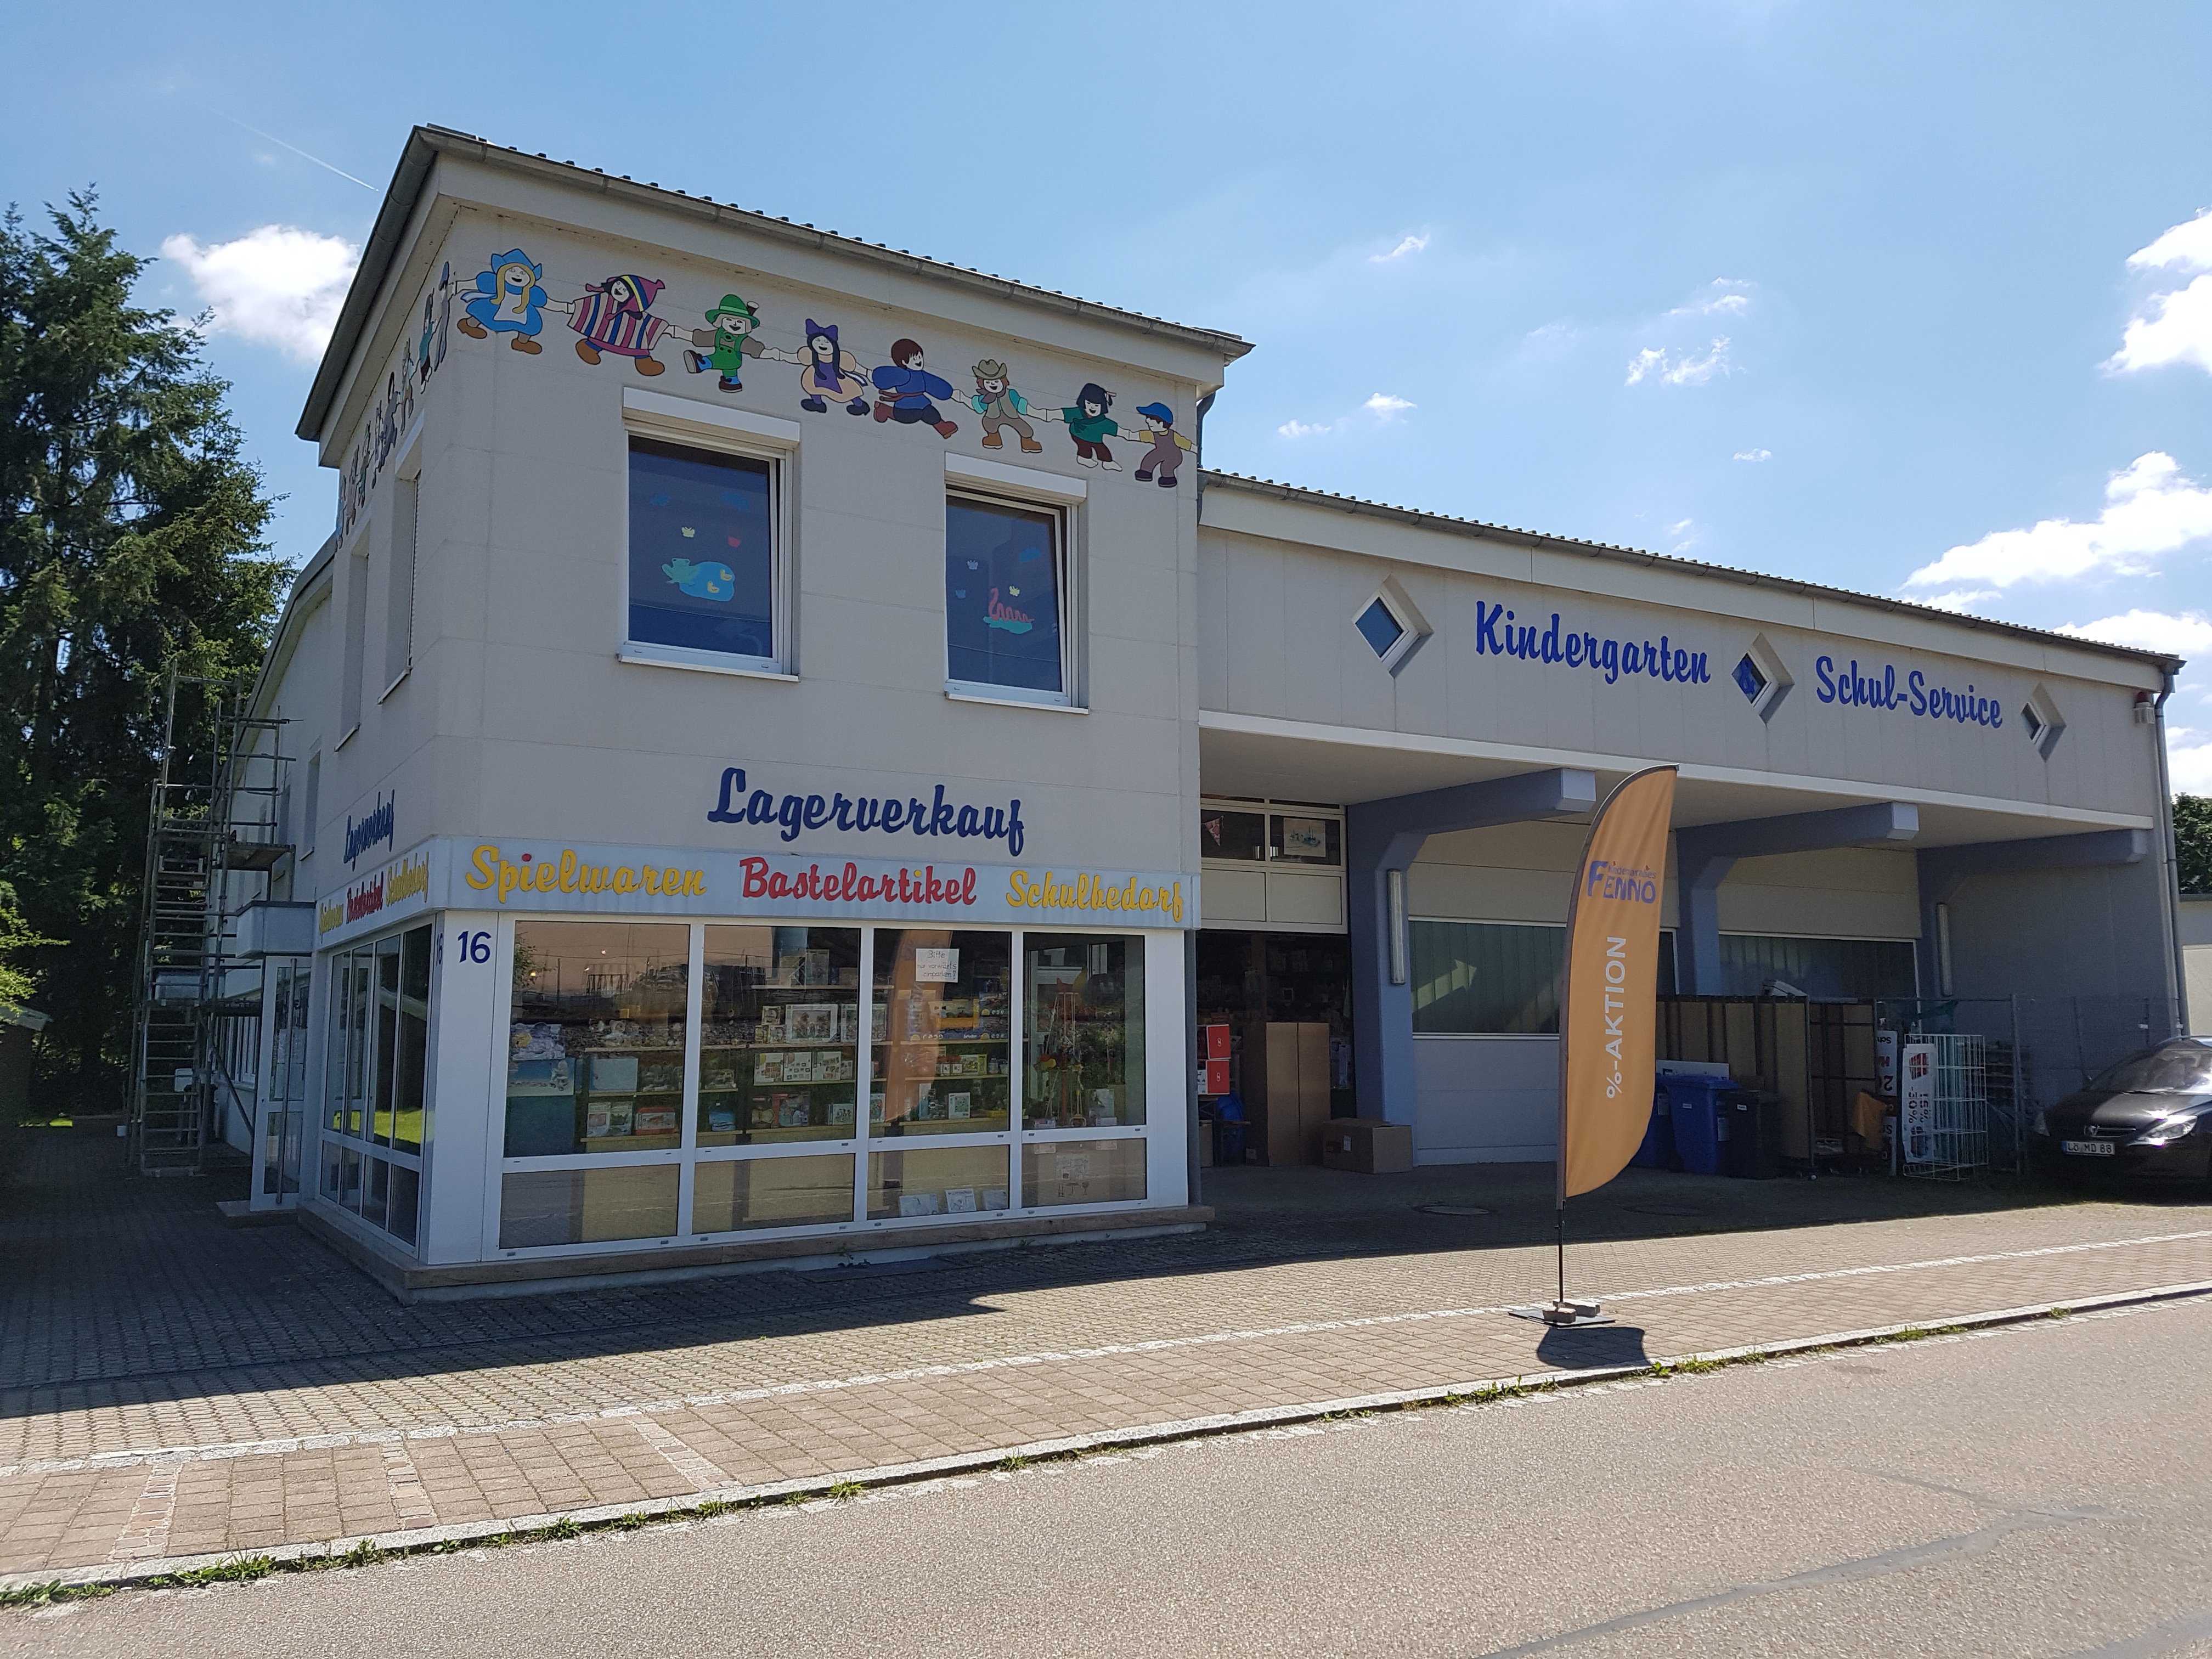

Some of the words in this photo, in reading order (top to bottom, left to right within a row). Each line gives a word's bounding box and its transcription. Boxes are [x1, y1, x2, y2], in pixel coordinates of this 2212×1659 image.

[1476, 601, 1711, 685] Kindergarten
[1739, 658, 1756, 695] &
[1815, 656, 2002, 729] Schul-Service
[707, 767, 1024, 856] Lagerverkauf
[466, 845, 707, 903] Spielwaren
[740, 857, 977, 905] Bastelartikel
[1006, 870, 1183, 922] Schulbedarf
[1588, 860, 1656, 904] FENNO
[436, 933, 443, 966] 16
[458, 931, 492, 963] 16
[928, 950, 946, 958] Bitte
[929, 961, 957, 969] vorwärts
[1605, 936, 1627, 1099] %-AKTION
